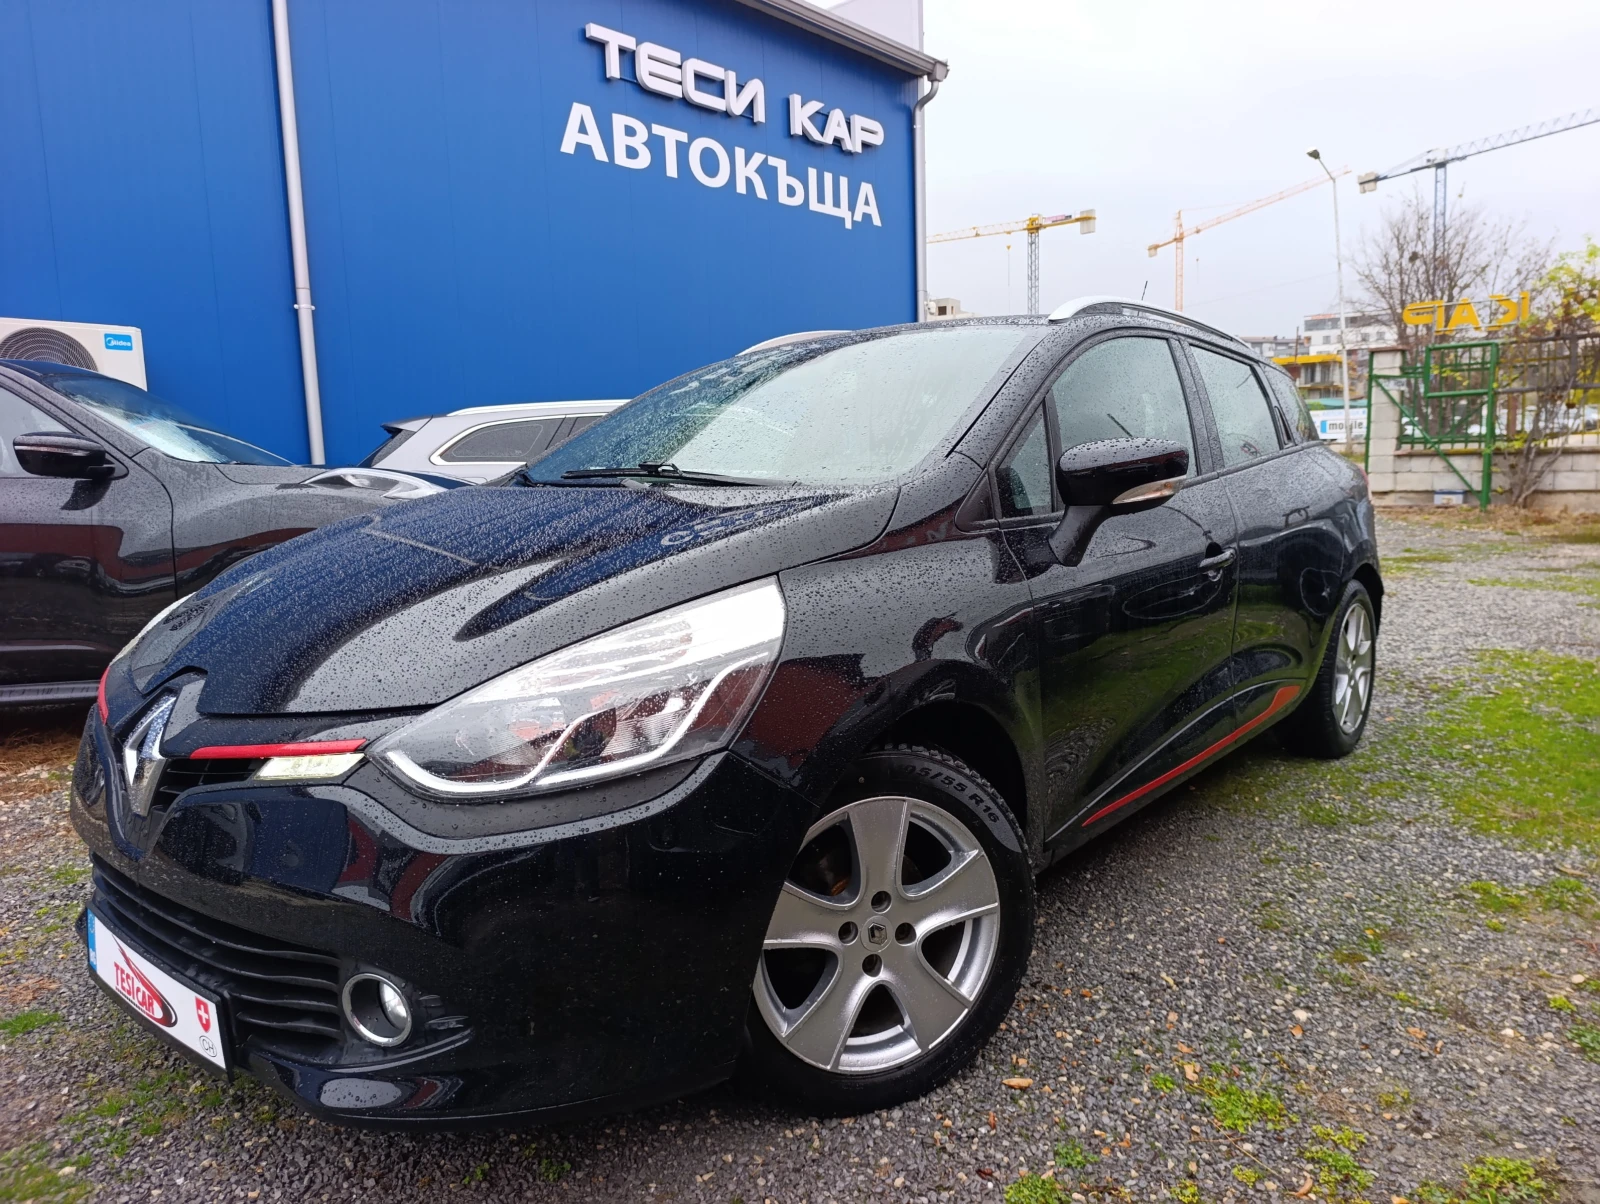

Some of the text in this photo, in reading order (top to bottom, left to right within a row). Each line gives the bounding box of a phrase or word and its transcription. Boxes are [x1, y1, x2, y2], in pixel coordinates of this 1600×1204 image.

[585, 22, 885, 154] ТЕСИ КАР
[560, 102, 882, 229] АВТОКЪЩА
[1328, 420, 1364, 431] moile
[968, 792, 1000, 824] R16
[202, 1038, 215, 1055] CH
